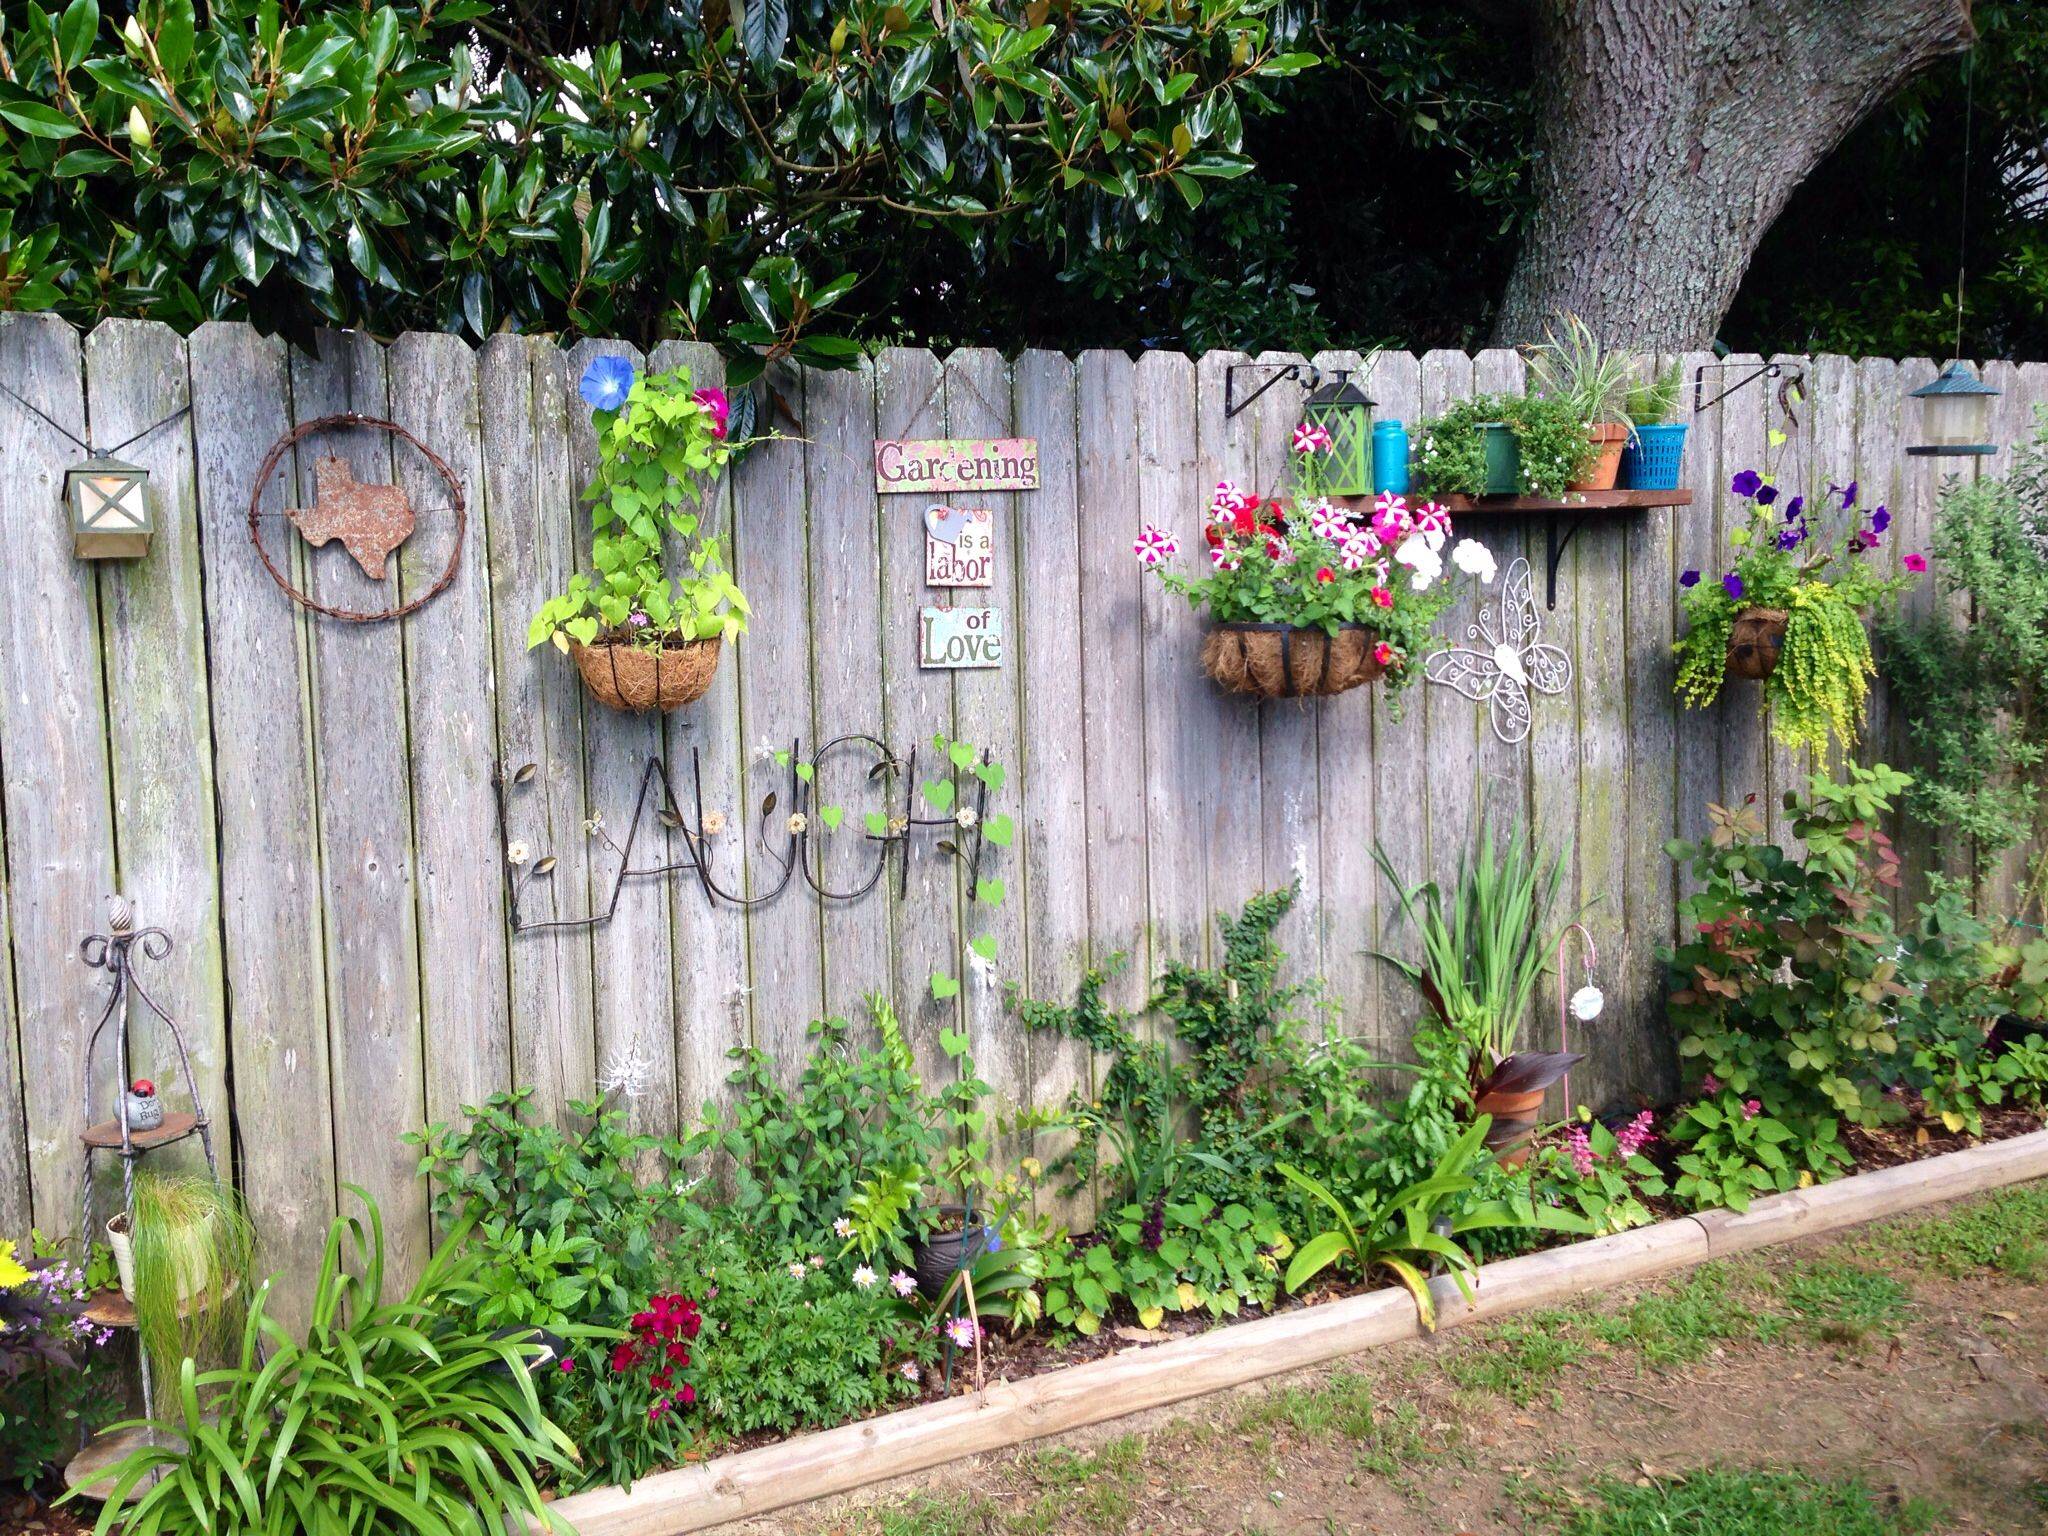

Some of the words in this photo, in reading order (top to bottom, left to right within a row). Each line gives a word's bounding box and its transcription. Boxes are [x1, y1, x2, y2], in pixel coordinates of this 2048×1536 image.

[959, 531, 973, 549] is
[980, 535, 990, 549] a
[929, 541, 991, 582] labor
[923, 616, 1001, 665] Love
[966, 611, 991, 630] of
[494, 735, 990, 932] LAUGH
